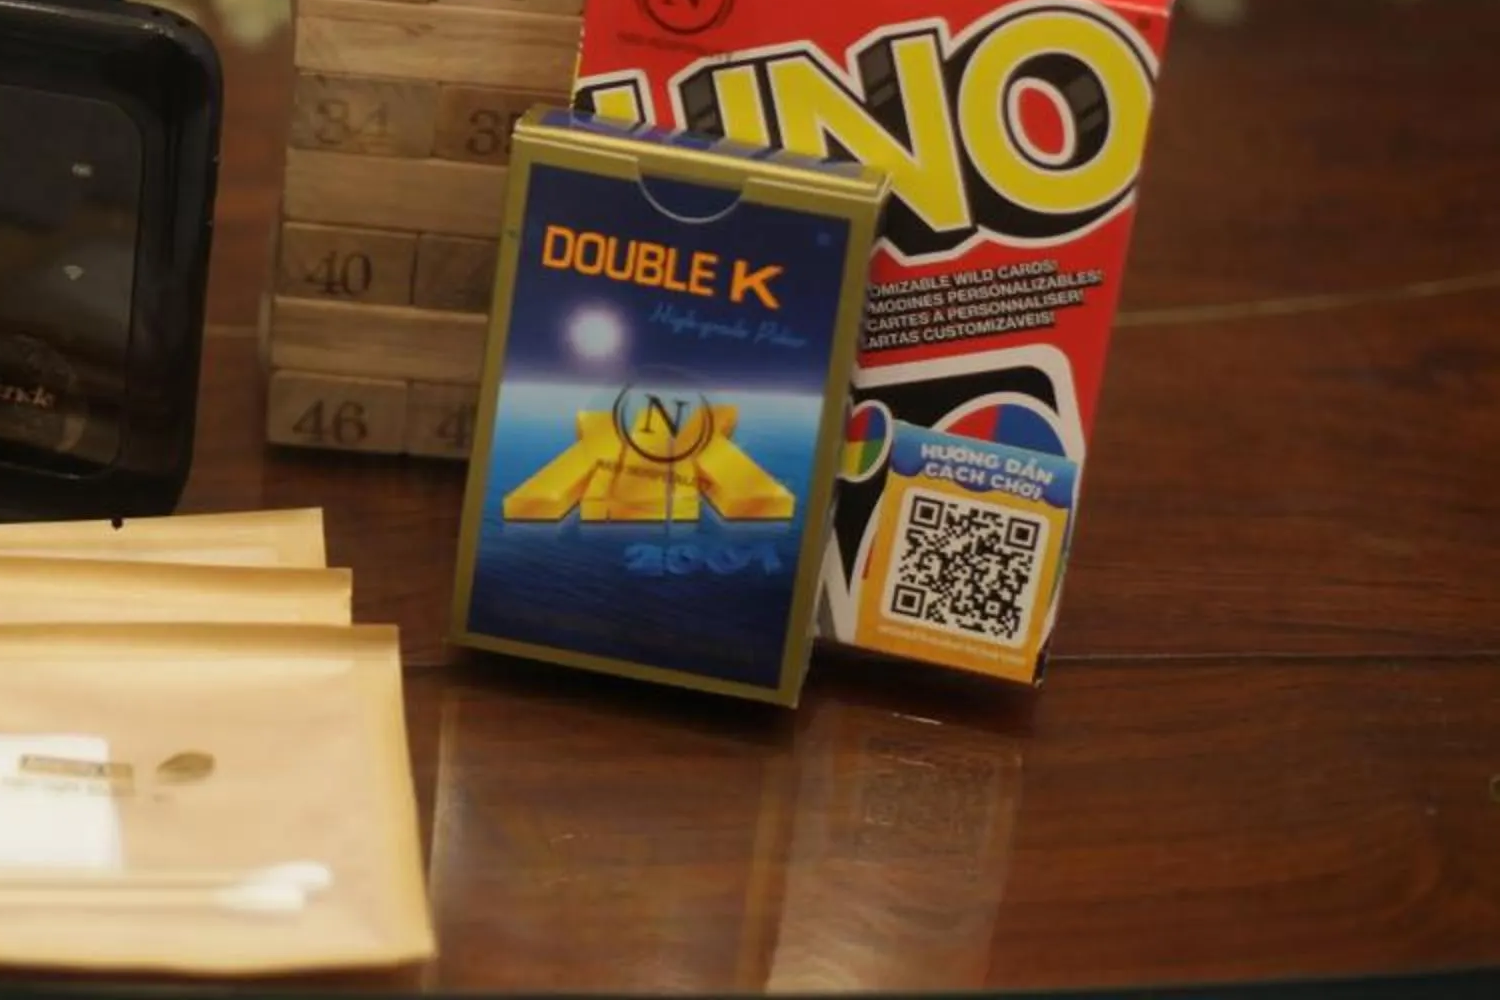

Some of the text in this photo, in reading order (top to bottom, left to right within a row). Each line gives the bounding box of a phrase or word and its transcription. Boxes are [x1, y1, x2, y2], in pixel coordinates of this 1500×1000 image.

[304, 250, 373, 296] 40
[542, 224, 785, 310] DOUBLE K
[869, 274, 951, 296] OMIZABLE
[953, 268, 994, 287] WILD
[868, 294, 944, 315] MODINES
[868, 329, 921, 350] ARTAS
[292, 400, 369, 445] 46
[640, 393, 690, 440] N
